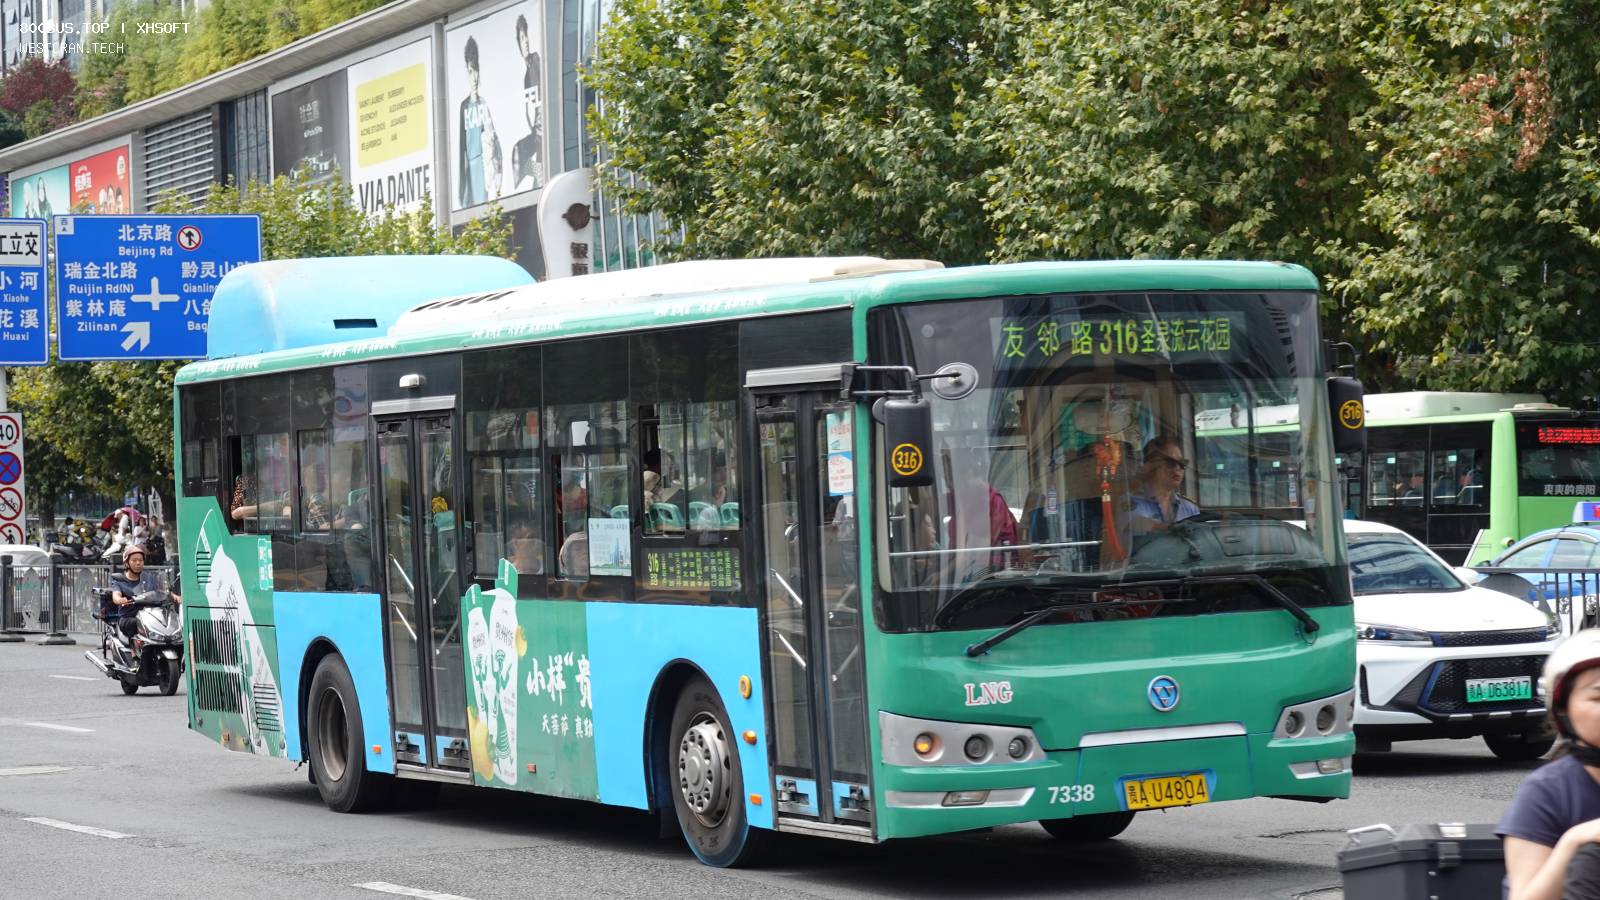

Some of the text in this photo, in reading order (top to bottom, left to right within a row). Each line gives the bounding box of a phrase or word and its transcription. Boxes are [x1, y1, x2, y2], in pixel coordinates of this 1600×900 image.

[359, 164, 430, 213] VIA DANTE
[118, 224, 172, 242] 北京路
[118, 246, 173, 258] Beijing Rd
[64, 261, 138, 279] 瑞金北路
[181, 261, 249, 278] 黔灵山
[3, 293, 30, 303] Xiaohe
[69, 284, 134, 296] Ruijin Rd(N)
[66, 299, 126, 317] 紫林庵
[0, 309, 39, 329] 花溪
[77, 321, 117, 332] Zilinan
[3, 331, 30, 341] Huaxi
[1099, 319, 1139, 355] 316
[1141, 317, 1231, 353] 圣泉流云花园
[1343, 405, 1361, 420] 316
[896, 451, 918, 469] 316
[1544, 484, 1596, 496] 爽爽的贵阳
[648, 552, 659, 573] 316
[964, 681, 1013, 706] LNG
[1048, 783, 1096, 804] 7338
